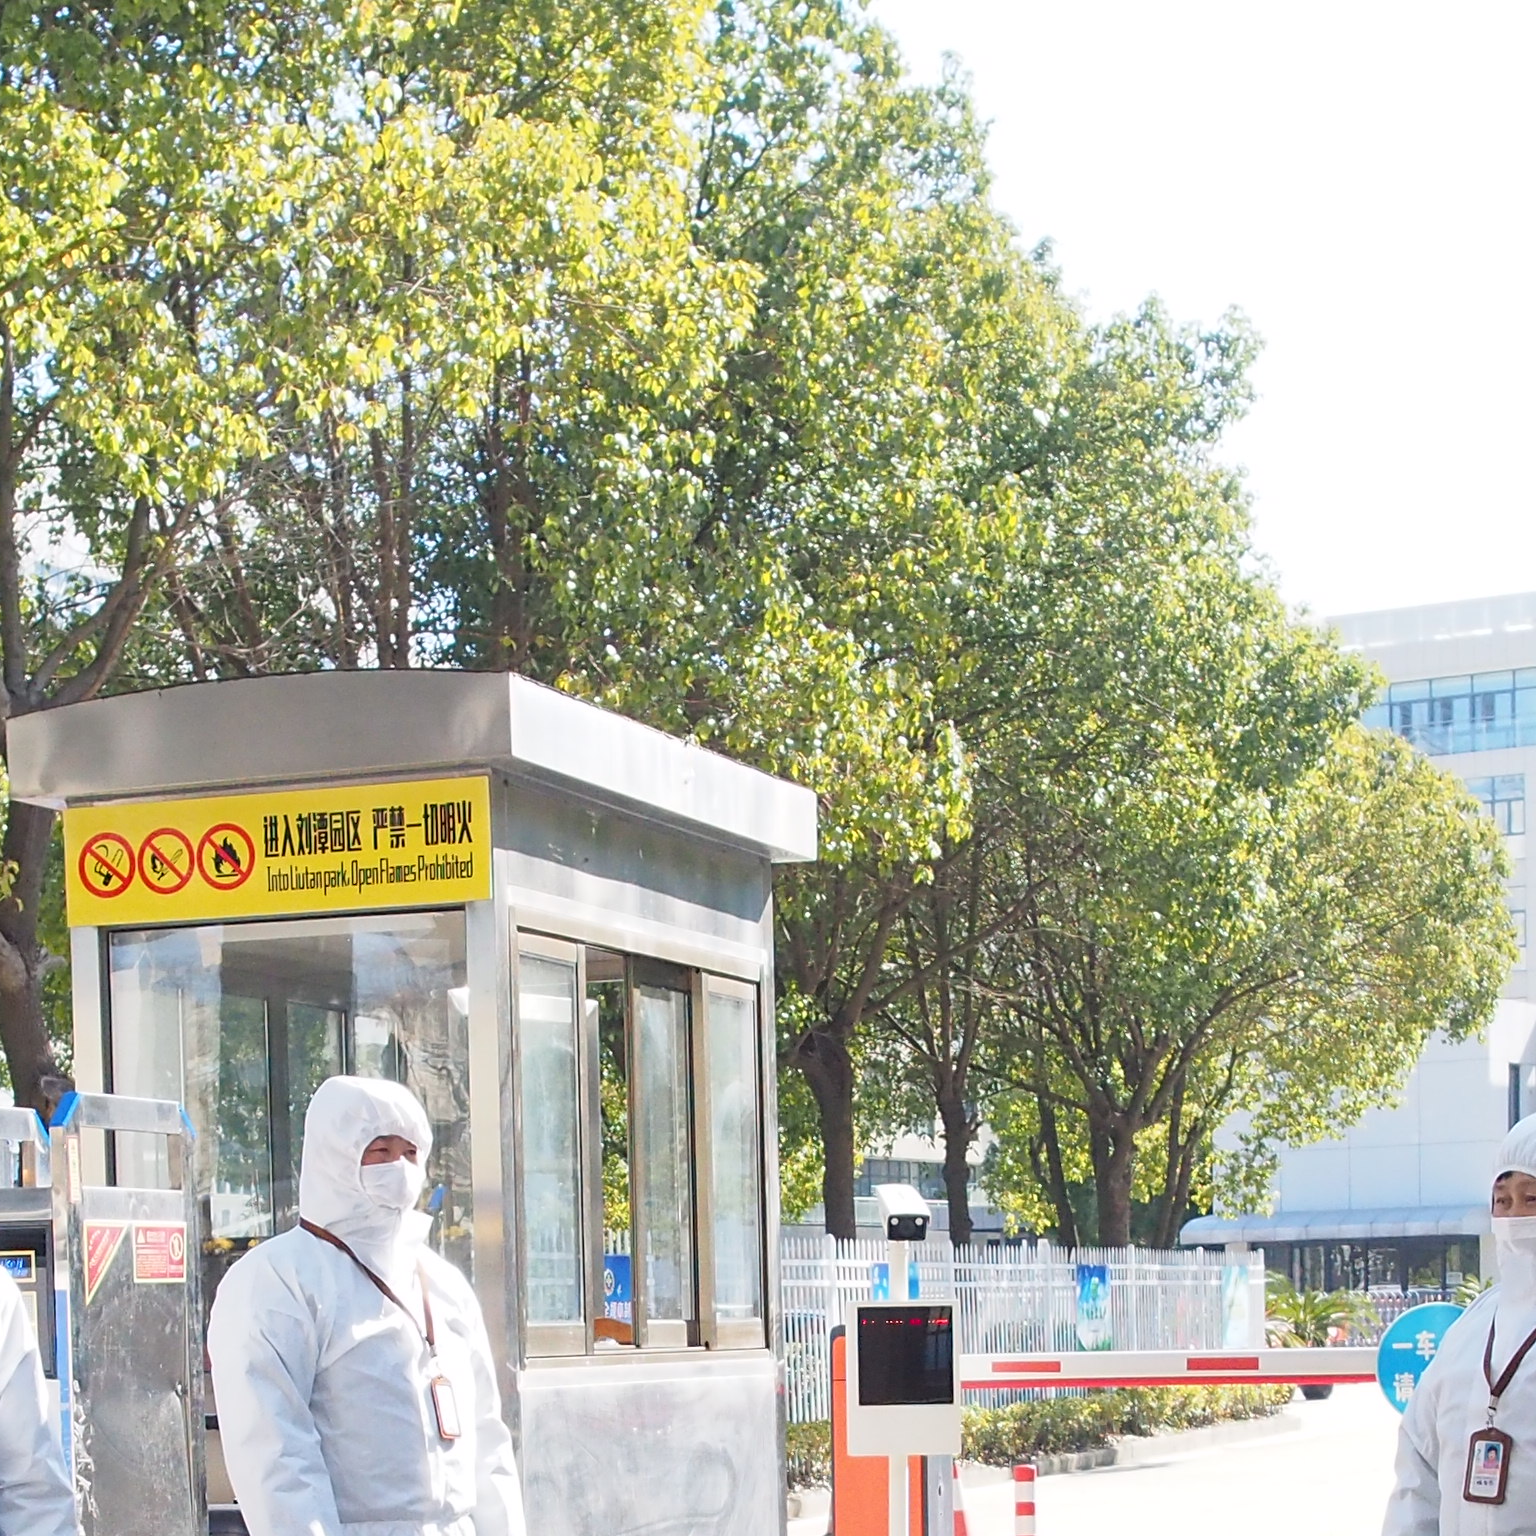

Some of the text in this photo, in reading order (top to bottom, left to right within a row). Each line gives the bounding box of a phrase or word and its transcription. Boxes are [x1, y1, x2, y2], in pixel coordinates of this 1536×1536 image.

[263, 801, 473, 858] 进入刘潭园区 严禁一切明火
[267, 865, 289, 892] Into
[290, 863, 322, 890] Liutan
[351, 860, 379, 894] Open
[417, 852, 473, 882] Prohibited
